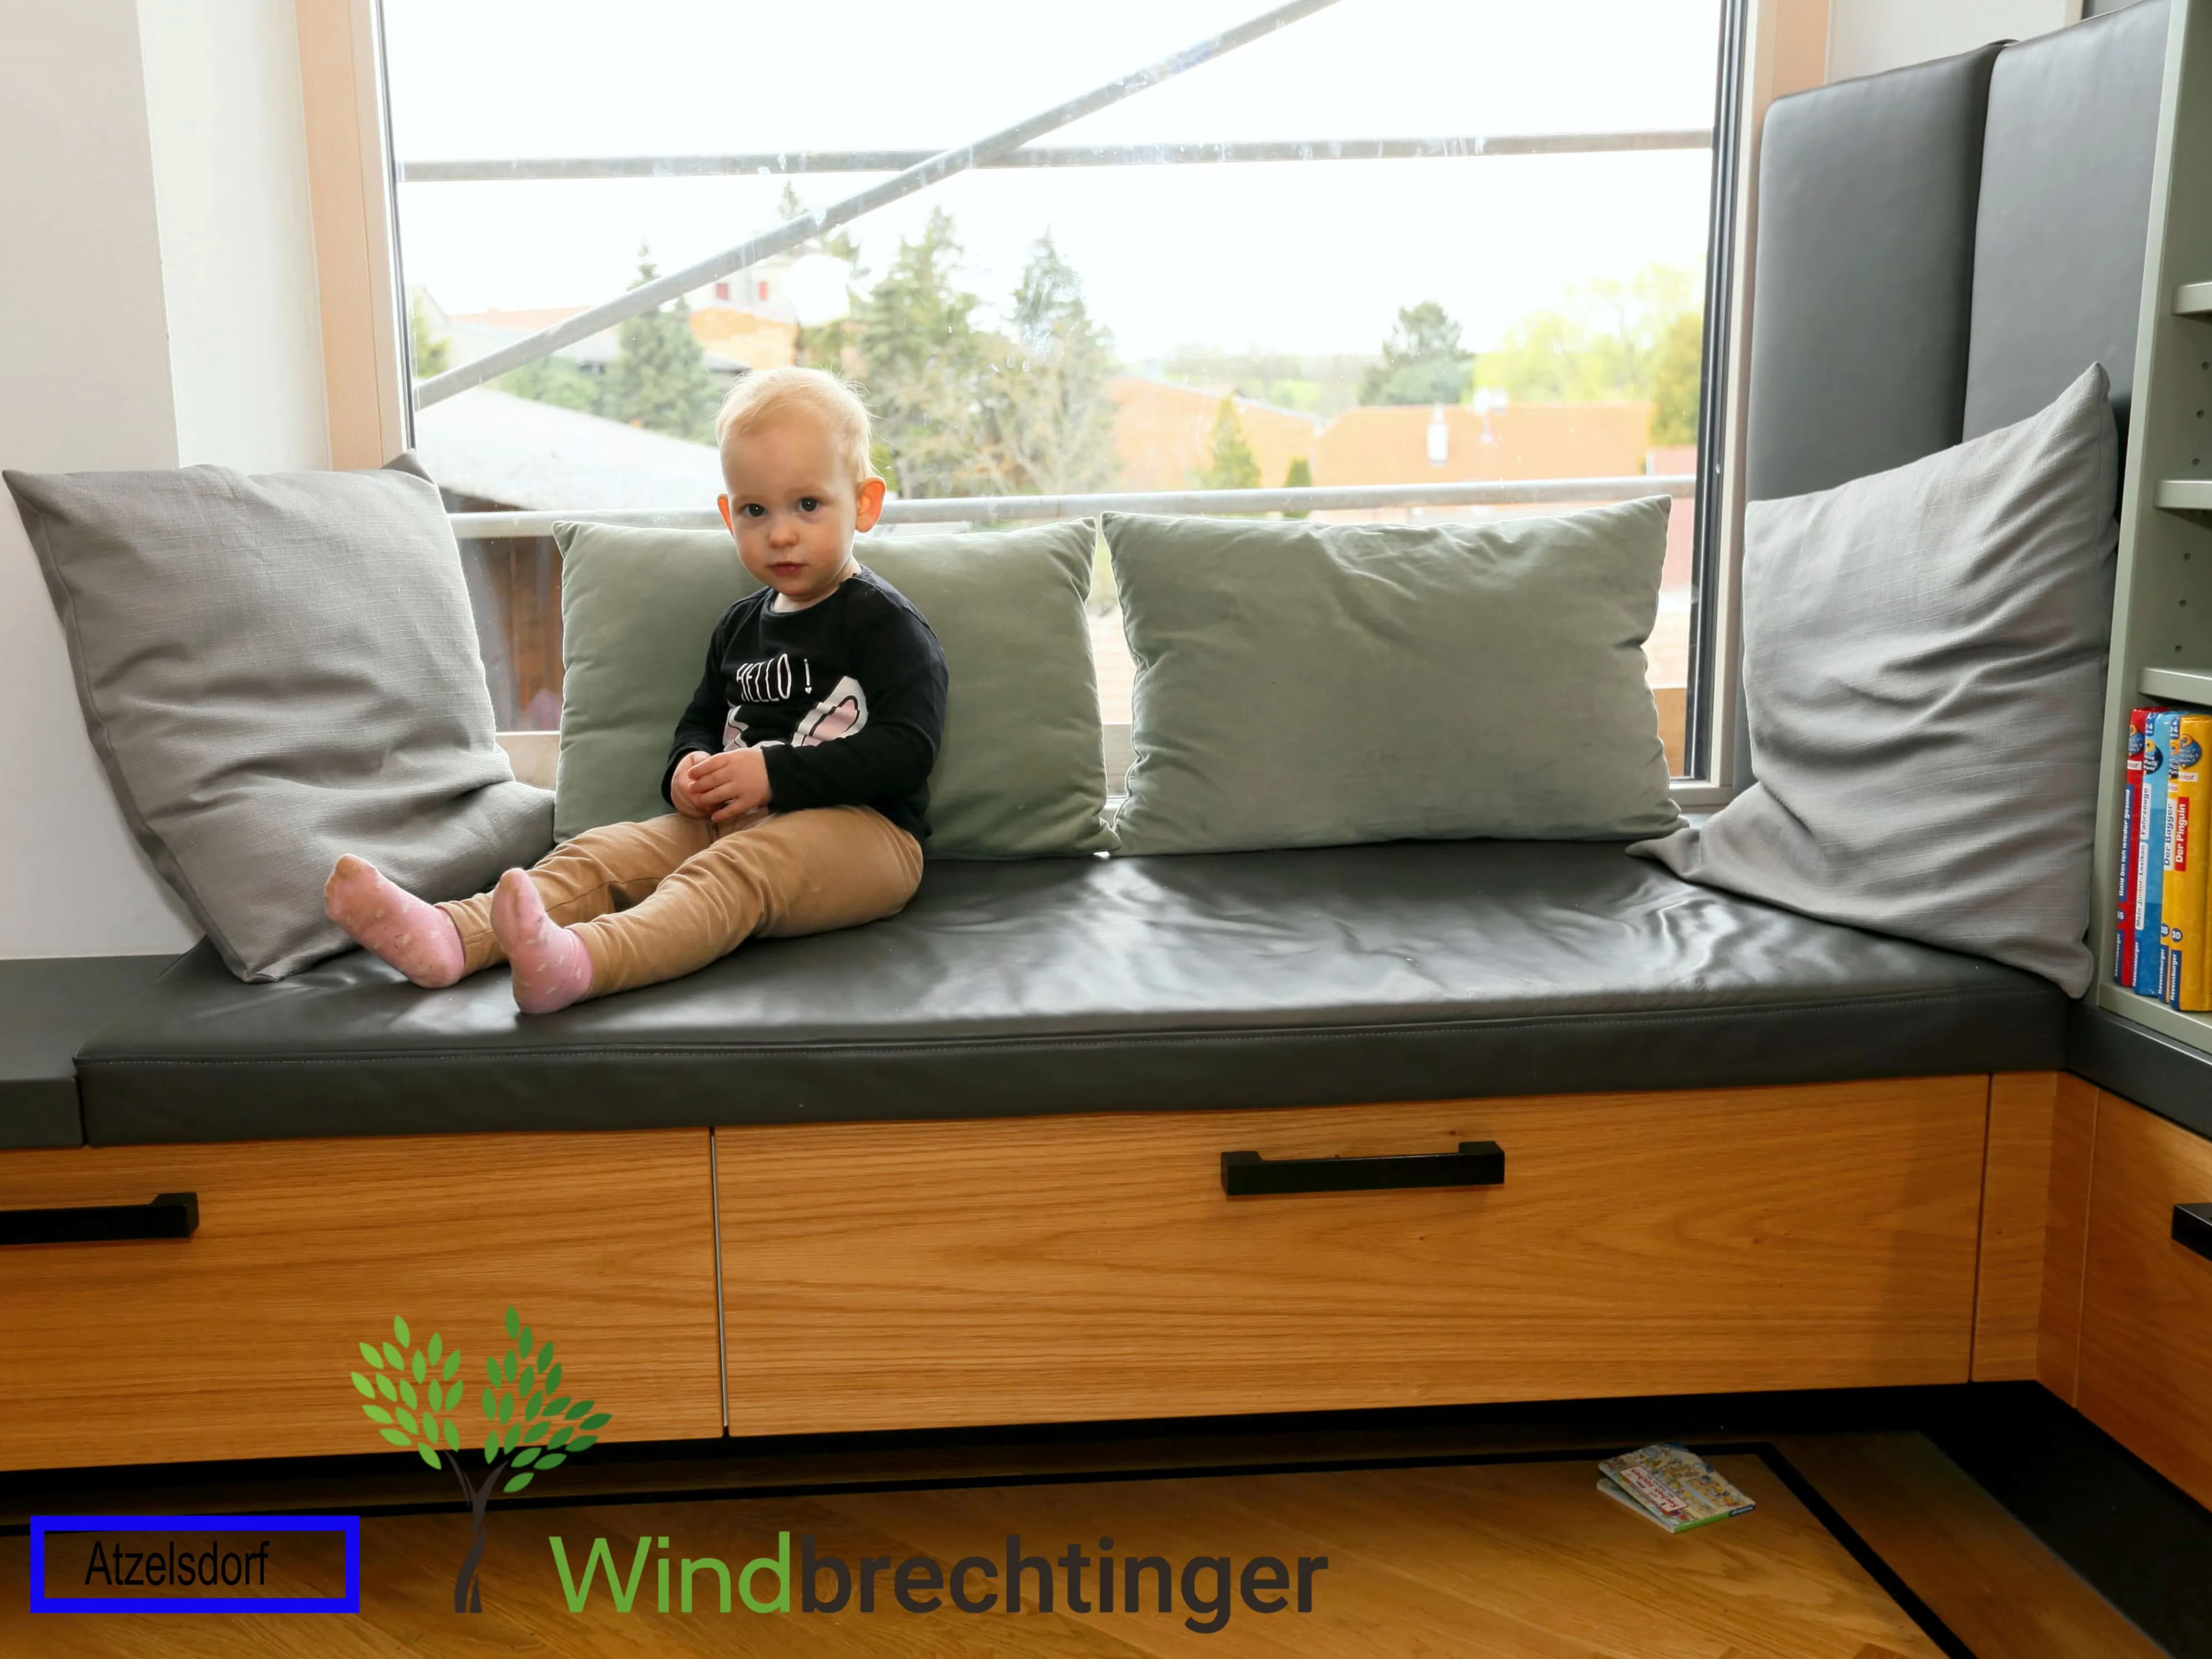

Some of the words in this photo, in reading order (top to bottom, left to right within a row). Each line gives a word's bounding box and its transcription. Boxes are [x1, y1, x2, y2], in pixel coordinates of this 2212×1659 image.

[2141, 788, 2149, 835] Fahrzeuge
[2165, 804, 2174, 843] Bagger
[2176, 804, 2188, 842] Pinguin
[2175, 843, 2184, 863] Der
[2171, 953, 2179, 1001] Ravensburger
